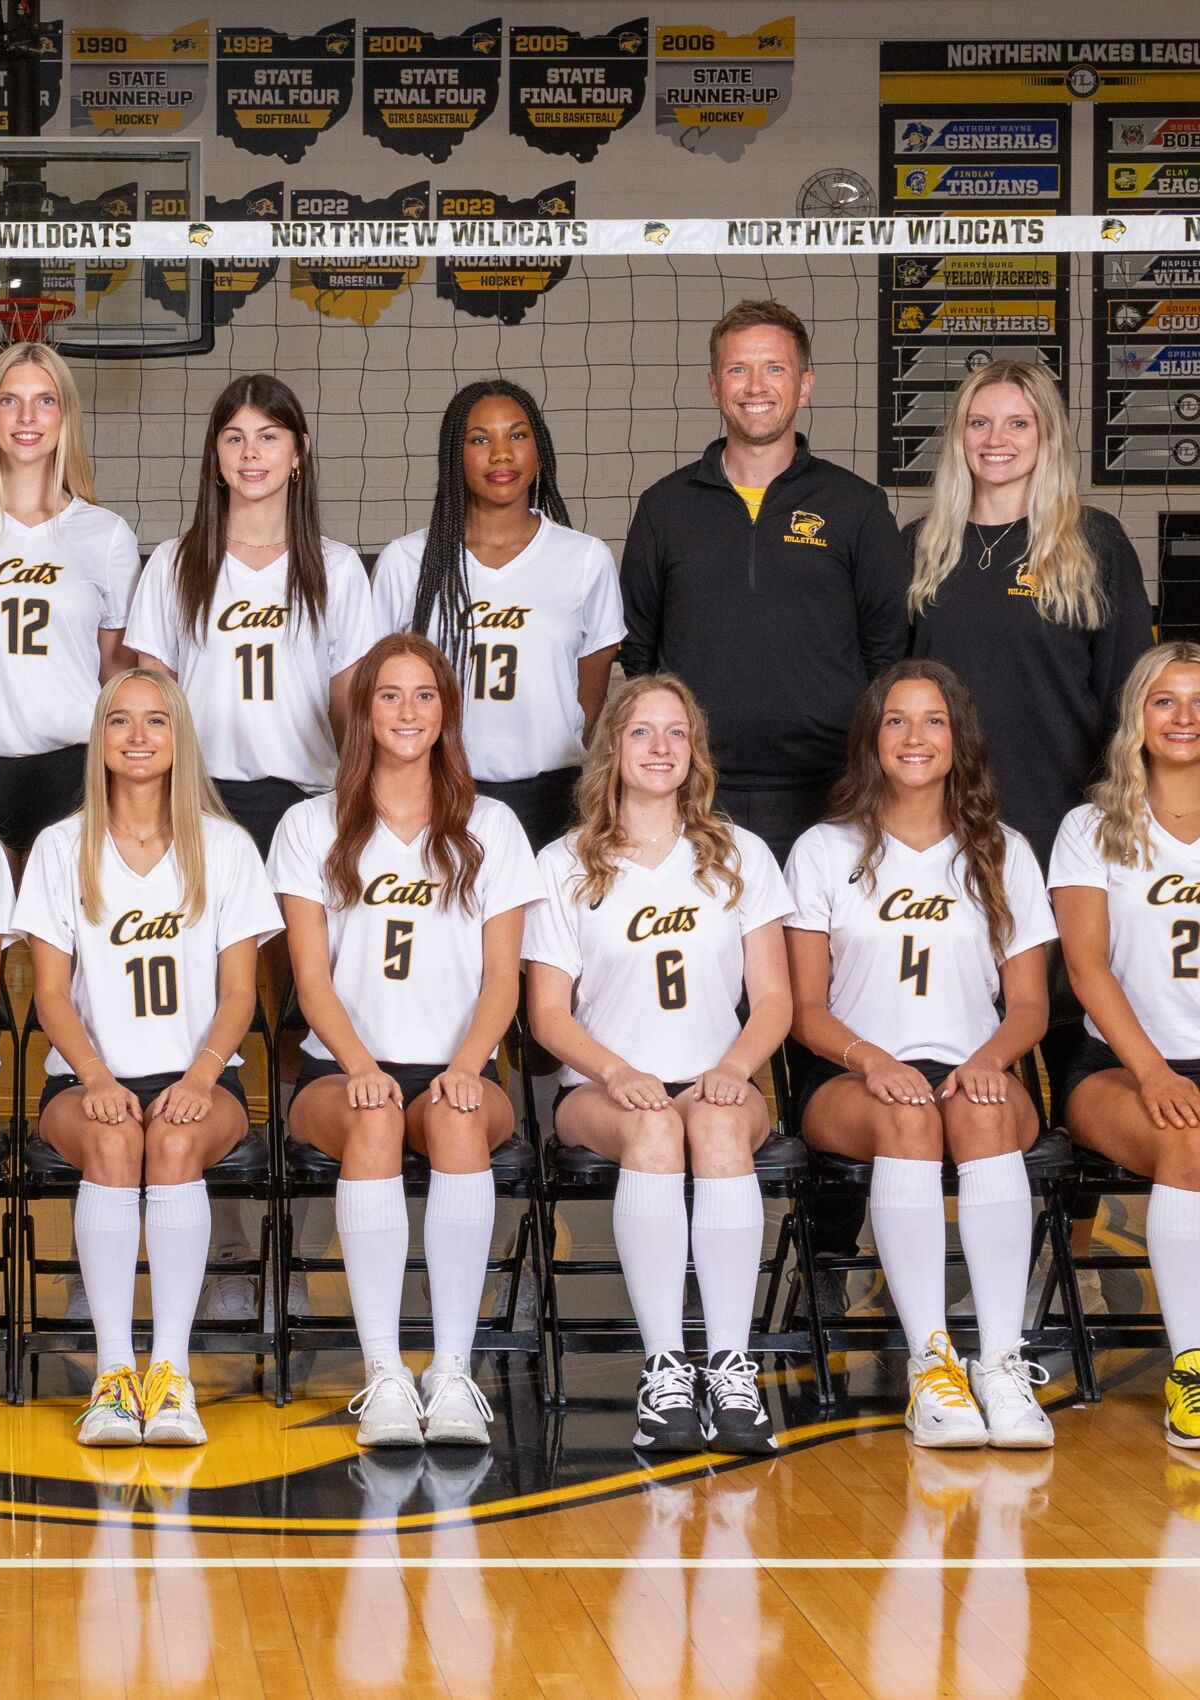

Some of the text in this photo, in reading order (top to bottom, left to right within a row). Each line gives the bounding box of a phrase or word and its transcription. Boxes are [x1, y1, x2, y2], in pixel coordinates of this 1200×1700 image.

[77, 37, 127, 53] 1990
[223, 36, 273, 53] 1992
[369, 35, 422, 52] 2004
[516, 35, 569, 52] 2005
[662, 35, 715, 50] 2006
[948, 44, 1061, 67] NORTHERN
[1068, 43, 1134, 62] LAKES
[108, 71, 167, 86] STATE
[254, 69, 313, 85] STATE
[401, 69, 459, 85] STATE
[547, 68, 606, 84] STATE
[693, 69, 751, 83] STATE
[82, 91, 194, 107] RUNNER-UP
[228, 89, 340, 105] FINAL FOUR
[374, 89, 486, 105] FINAL FOUR
[521, 88, 633, 104] FINAL FOUR
[667, 89, 779, 104] RUNNER-UP
[115, 114, 159, 125] HOCKEY
[256, 114, 310, 124] SOFTBALL
[388, 113, 470, 124] GIRLS BASKETBALL
[535, 112, 617, 123] GIRLS BASKETBALL
[700, 112, 744, 122] HOCKEY
[944, 133, 1053, 150] GENERALS
[954, 170, 995, 178] FINDLAY
[1166, 169, 1189, 177] CLAY
[947, 179, 1039, 195] TROJANS
[1158, 178, 1200, 194] EAG
[151, 200, 187, 215] 201
[297, 199, 349, 215] 2022
[443, 199, 494, 214] 2023
[270, 222, 587, 247] NORTHVIEW WILDCATS
[726, 219, 1043, 245] NORTHVIEW WILDCATS
[329, 275, 384, 286] BASEBALL
[480, 276, 525, 286] HOCKEY
[944, 270, 1051, 286] YELLOW JACKETS
[941, 315, 1050, 332] PANTHERS
[783, 534, 828, 547] VOLLEYBALL
[218, 599, 291, 631] Cats
[460, 601, 534, 631] Cats
[1, 597, 50, 656] 12
[235, 643, 274, 701] 11
[470, 643, 518, 701] 13
[363, 873, 440, 906] Cats
[879, 888, 958, 921] Cats
[110, 909, 185, 945] Cats
[627, 905, 701, 942] Cats
[384, 919, 413, 980] 5
[900, 933, 931, 997] 4
[125, 955, 179, 1018] 10
[656, 949, 688, 1010] 6
